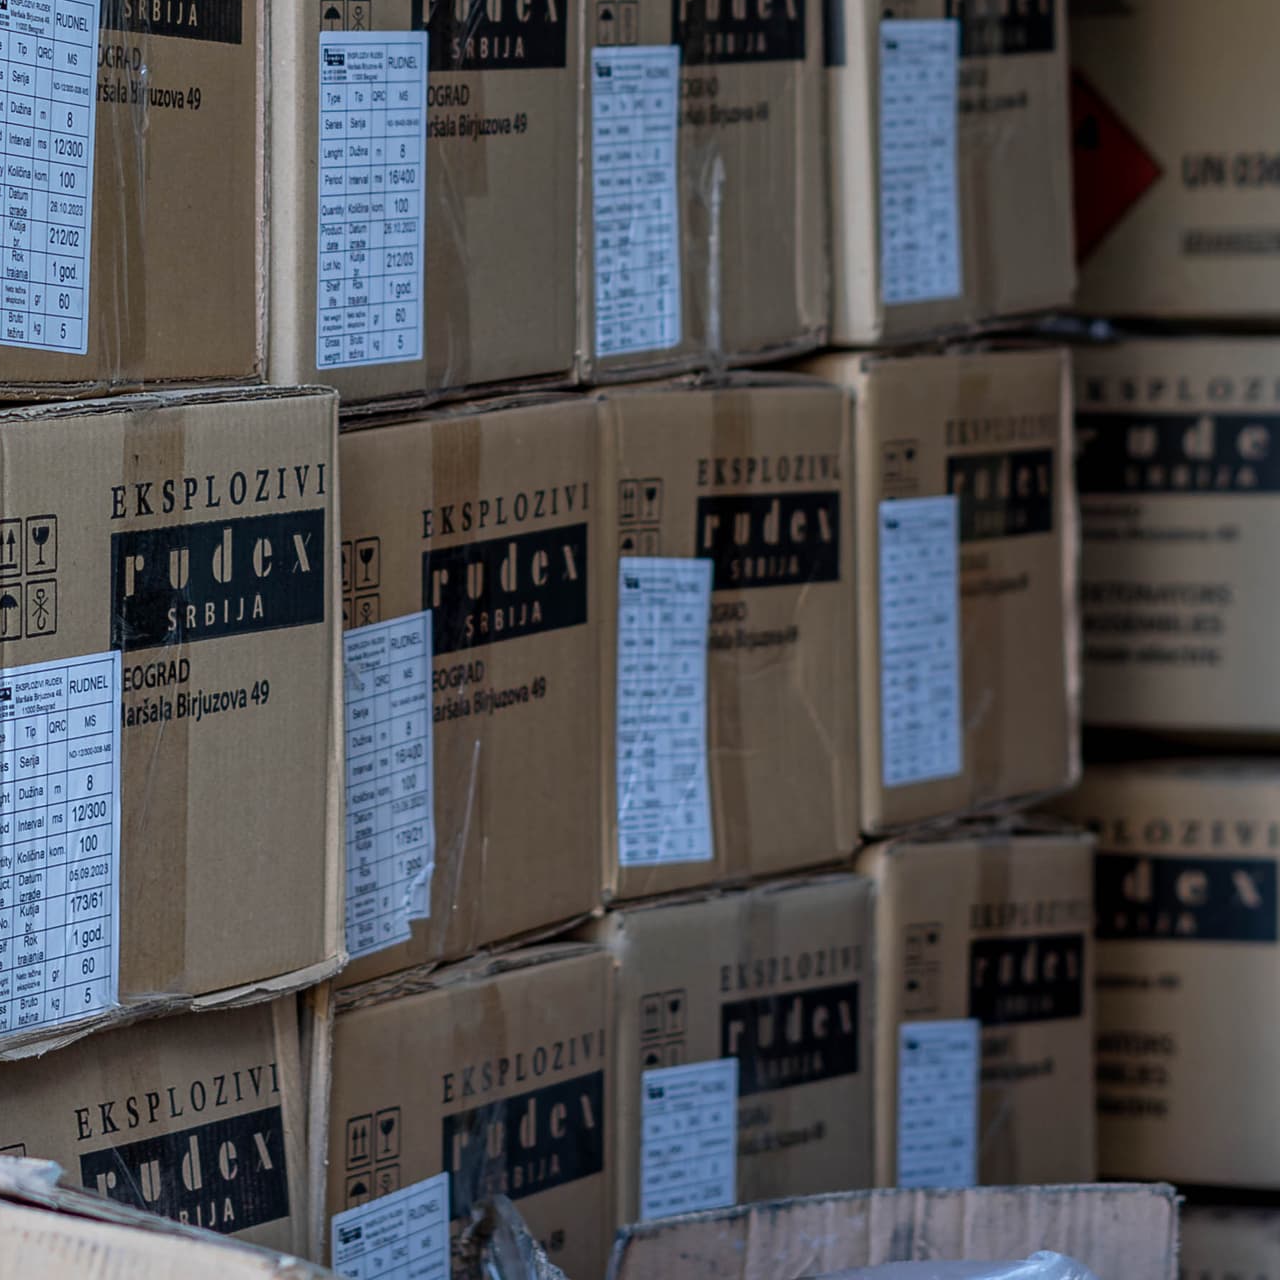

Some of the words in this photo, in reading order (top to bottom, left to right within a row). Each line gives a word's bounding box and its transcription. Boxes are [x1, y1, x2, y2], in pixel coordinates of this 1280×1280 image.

[123, 0, 198, 28] SRBIJA
[388, 55, 418, 70] RUDNEL
[451, 37, 526, 60] SRBIJA
[54, 138, 83, 157] 12/300
[49, 228, 79, 247] 212/02
[111, 463, 327, 520] EKSPLOZIVI
[422, 481, 590, 539] EKSPLOZIVI
[704, 499, 832, 548] rudex
[125, 526, 312, 598] rudex
[432, 542, 579, 607] rudex
[167, 593, 265, 632] SRBIJA
[465, 607, 542, 639] SRBIJA
[70, 675, 108, 694] RUDNEL
[122, 657, 190, 693] EOGRAD
[175, 684, 248, 722] Birjuzova
[251, 679, 271, 706] 49
[85, 715, 96, 728] MS
[72, 800, 106, 822] 12/300
[80, 834, 98, 853] 100
[70, 891, 104, 913] 173/61
[721, 945, 864, 992] EKSPLOZIVI
[442, 1029, 606, 1105] EKSPLOZIVI
[74, 1062, 280, 1141] EKSPLOZIVI
